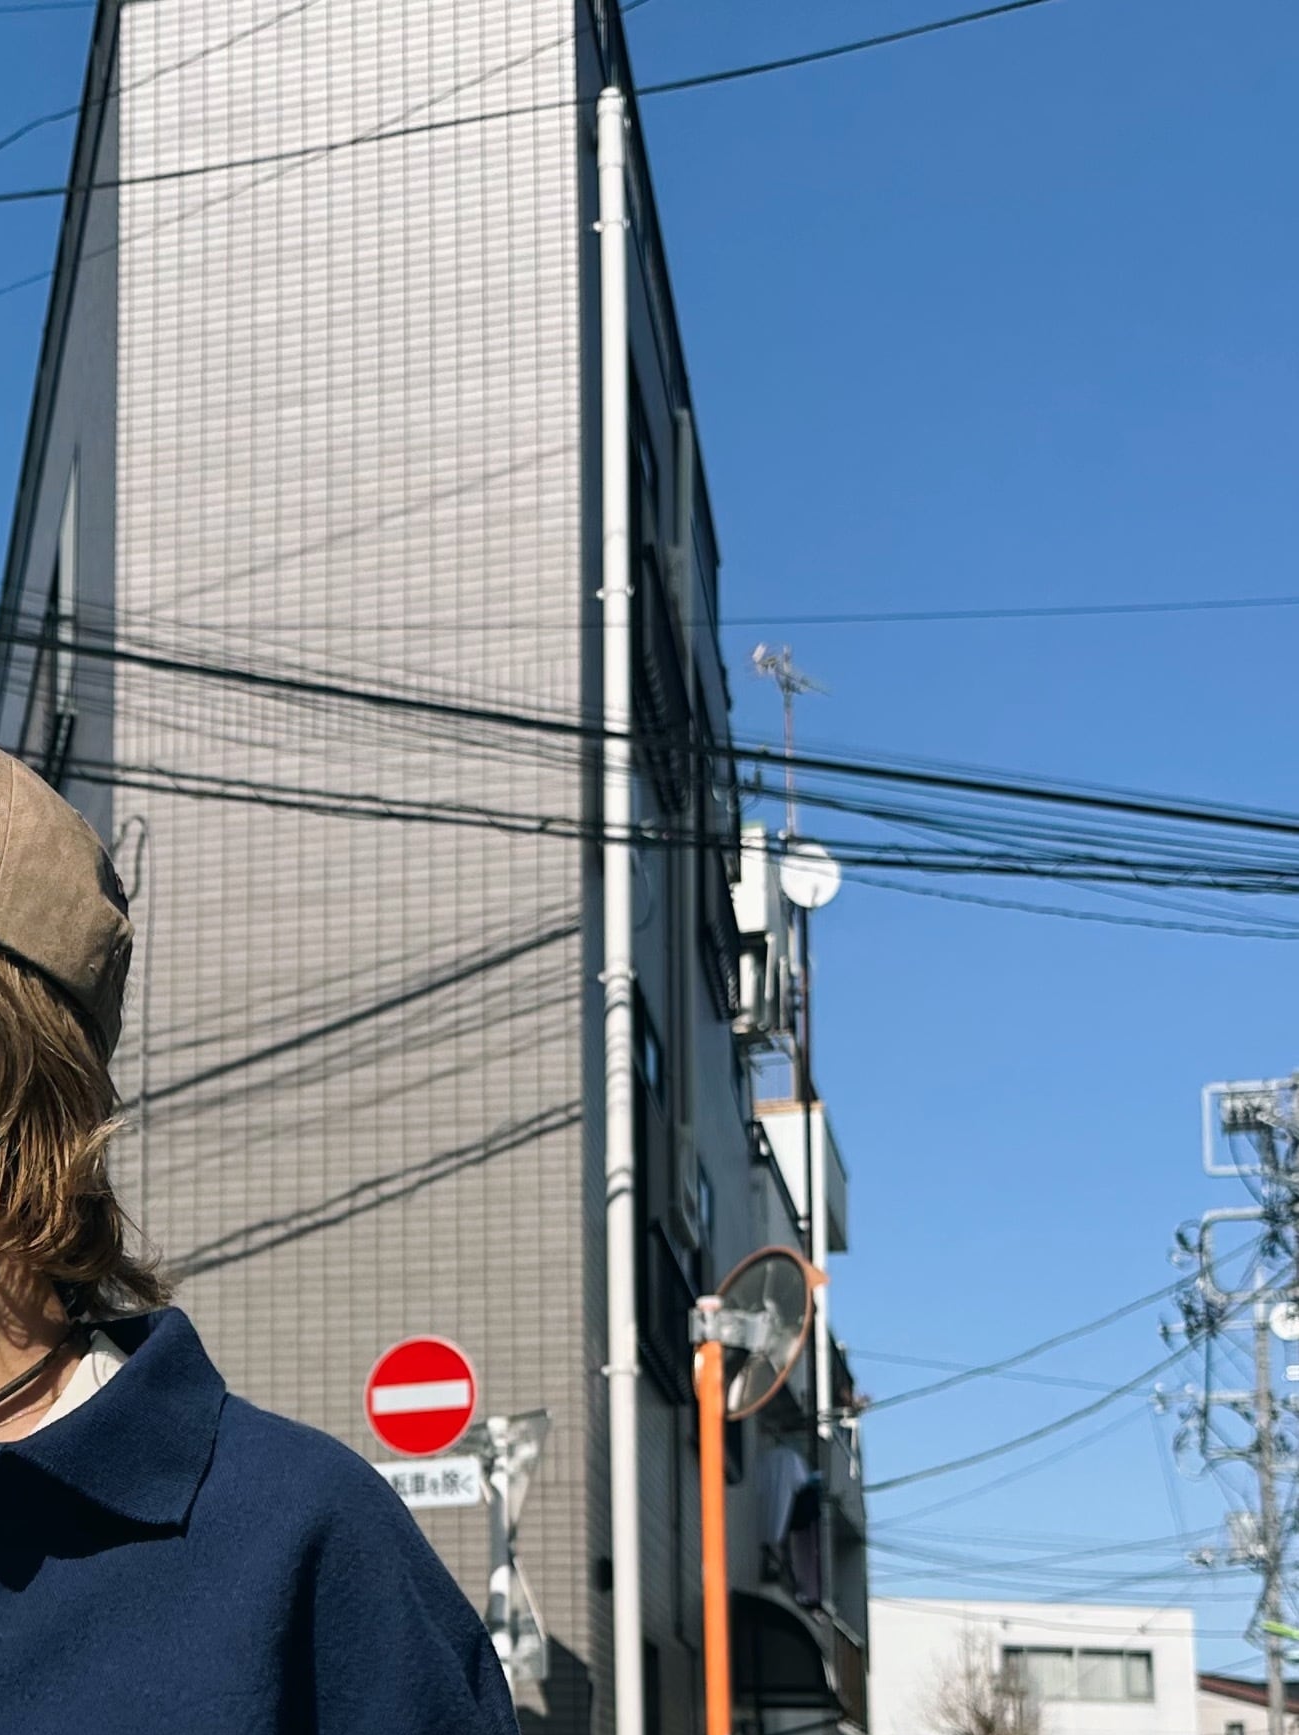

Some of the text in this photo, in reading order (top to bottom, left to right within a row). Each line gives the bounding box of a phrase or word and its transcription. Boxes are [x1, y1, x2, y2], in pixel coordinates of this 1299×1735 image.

[391, 1469, 474, 1496] 転車を除く
